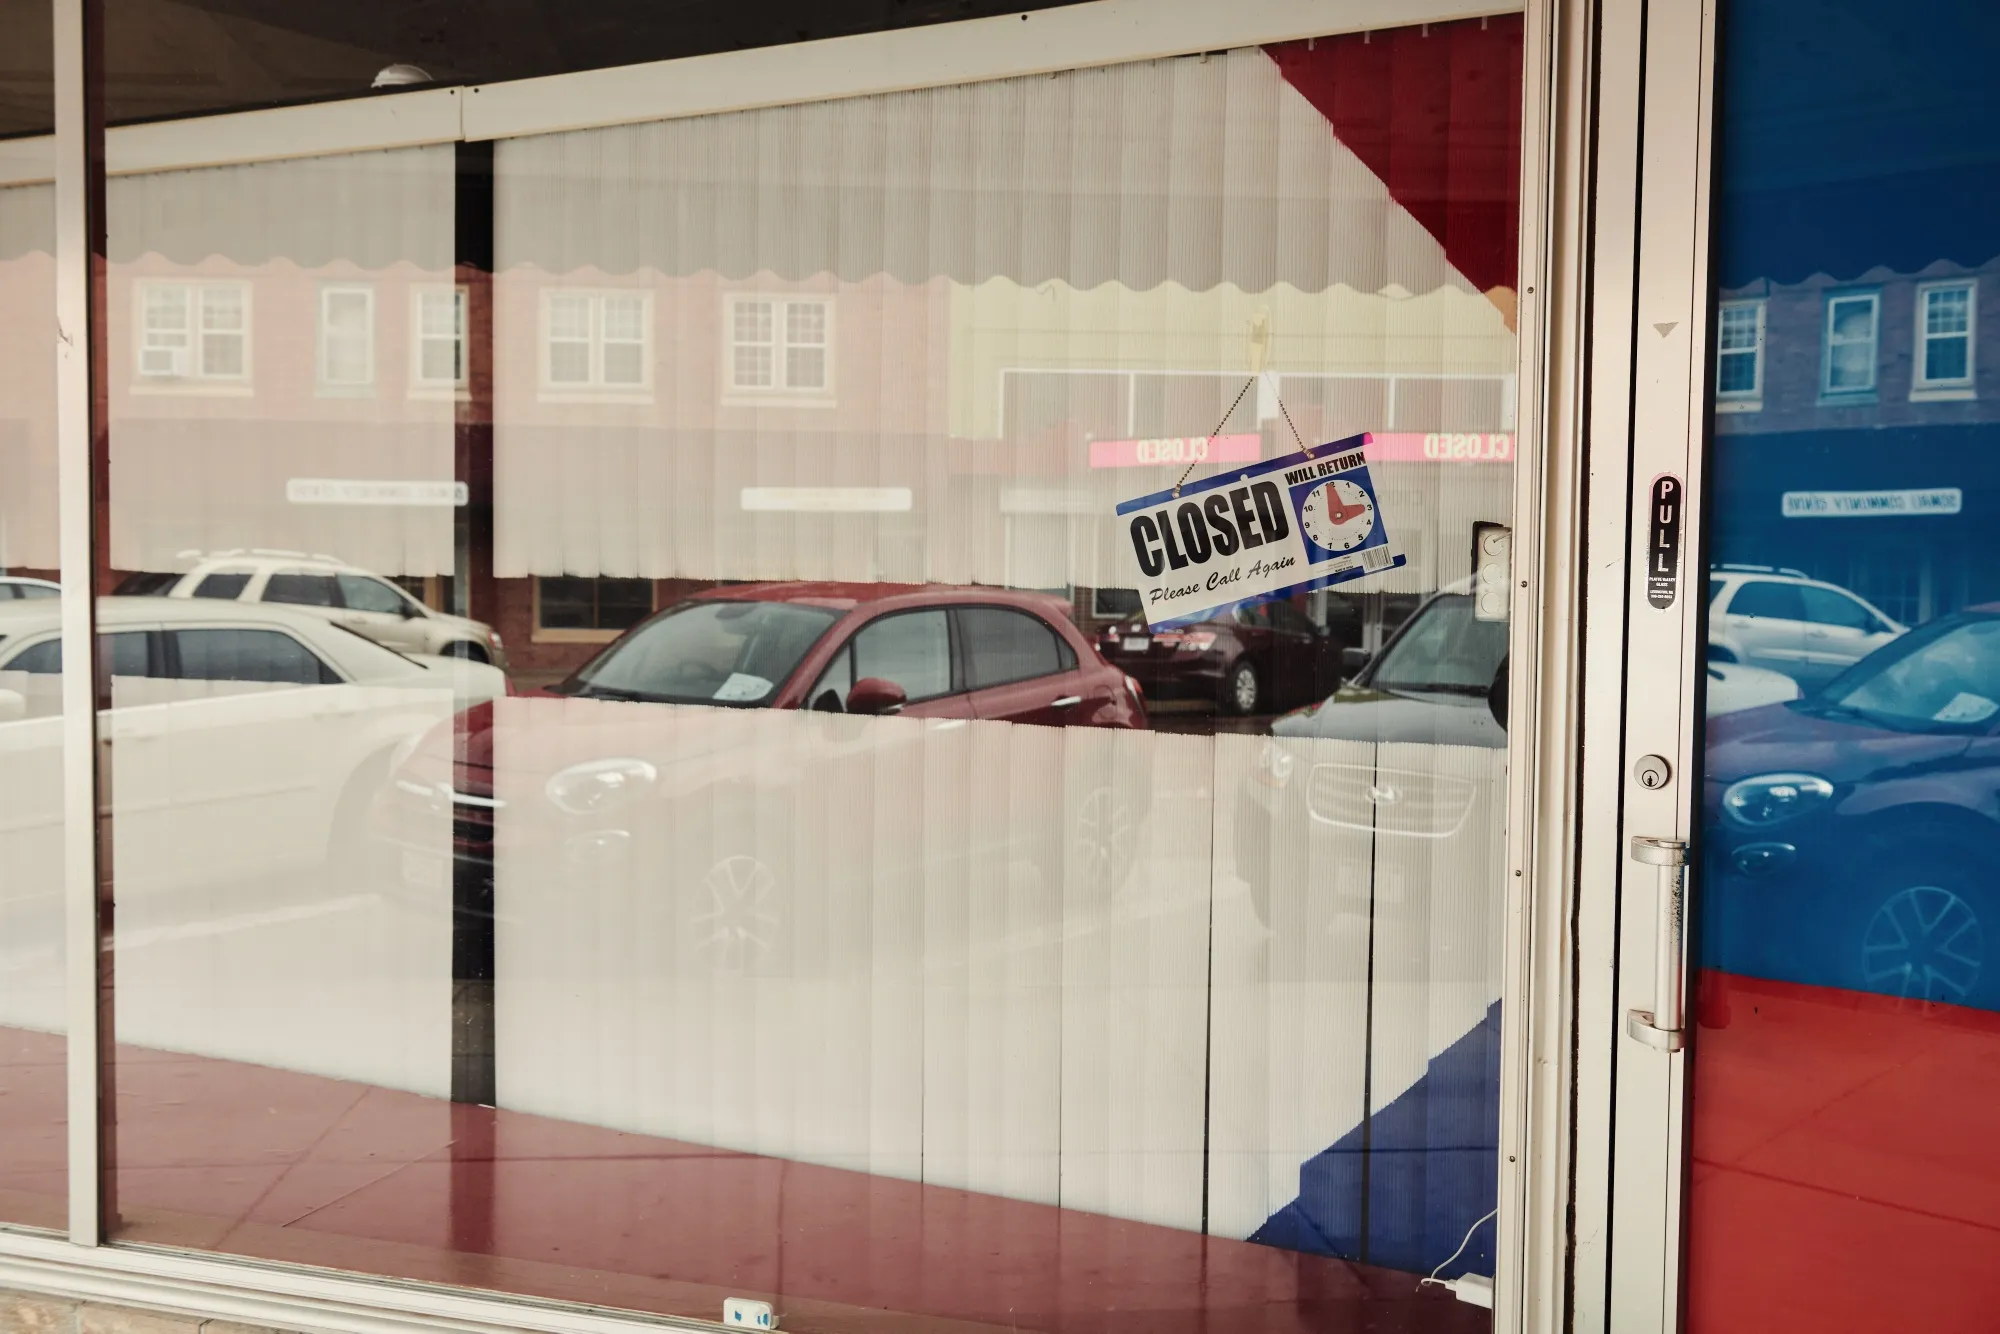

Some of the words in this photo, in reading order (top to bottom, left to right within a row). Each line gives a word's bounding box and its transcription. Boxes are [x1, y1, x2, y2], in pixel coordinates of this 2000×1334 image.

[1284, 466, 1316, 485] WILL
[1317, 452, 1366, 476] RETURN
[1130, 481, 1289, 577] CLOSED
[1658, 481, 1674, 572] PULL
[1149, 582, 1200, 605] Please
[1206, 567, 1241, 591] Call
[1247, 556, 1296, 578] Again
